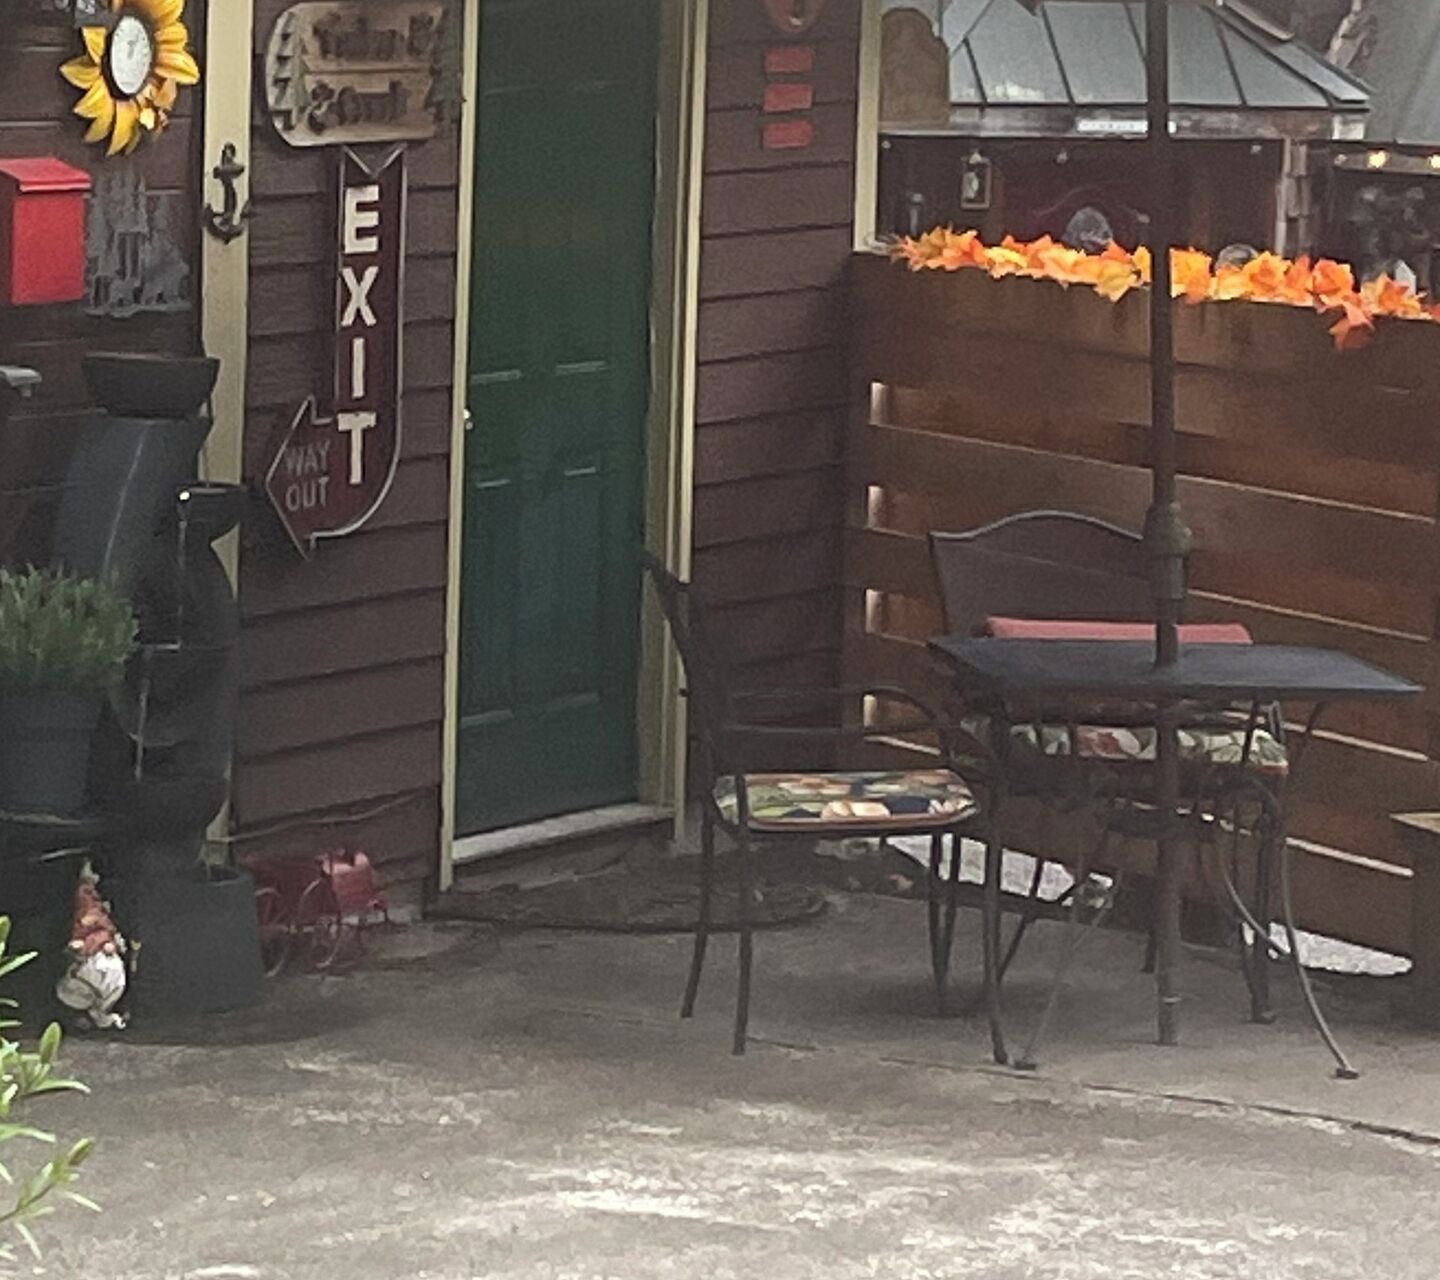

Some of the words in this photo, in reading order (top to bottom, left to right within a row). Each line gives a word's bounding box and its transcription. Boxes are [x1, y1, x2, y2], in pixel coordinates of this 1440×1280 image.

[337, 184, 379, 485] EXIT
[285, 439, 331, 476] WAY
[285, 475, 331, 512] OUT
